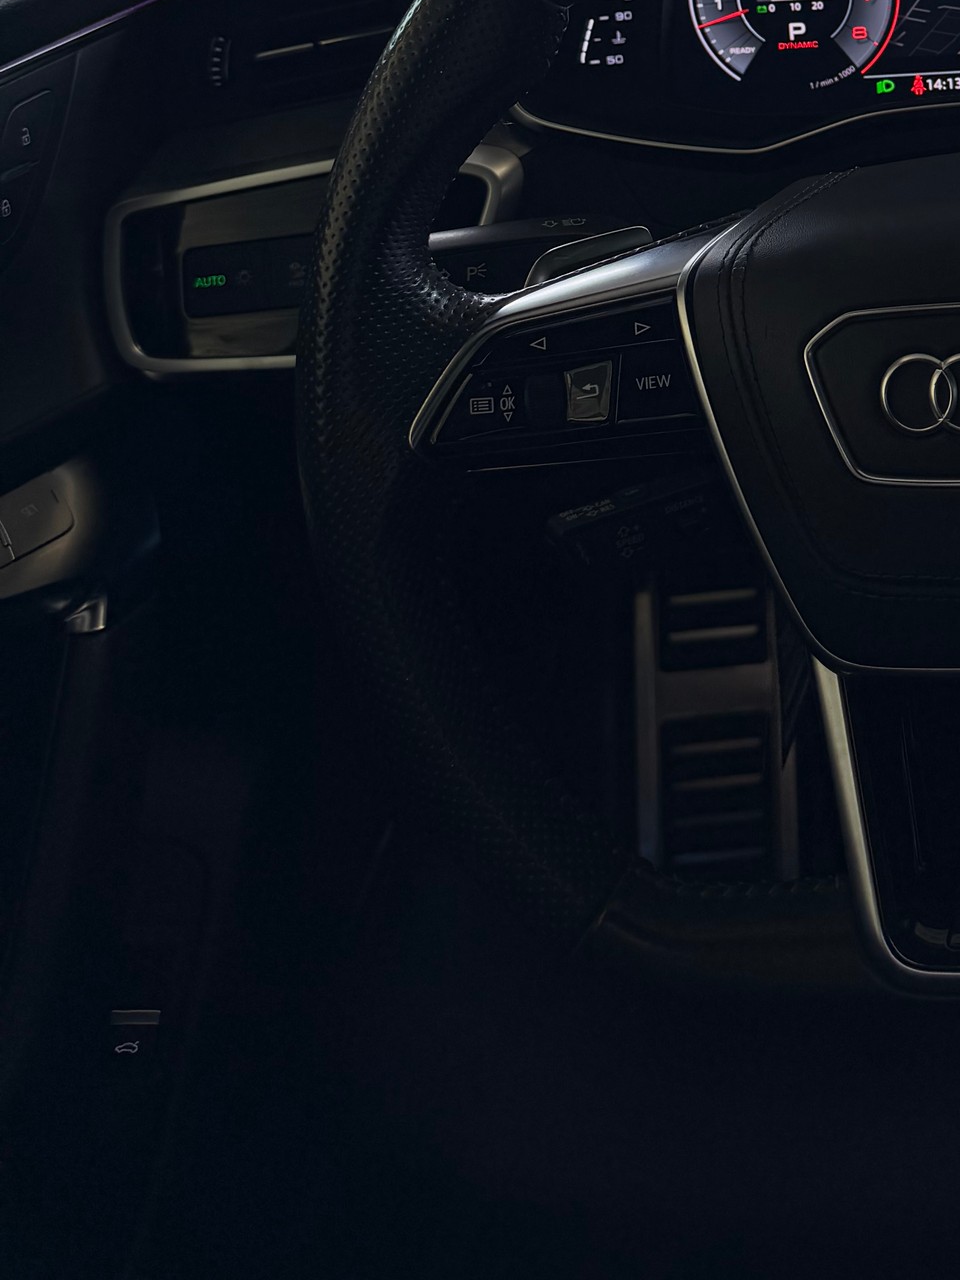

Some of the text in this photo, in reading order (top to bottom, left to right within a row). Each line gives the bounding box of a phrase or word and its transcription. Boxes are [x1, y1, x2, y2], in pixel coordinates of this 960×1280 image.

[768, 3, 776, 13] 0
[790, 2, 801, 11] 10
[811, 1, 824, 10] 20
[615, 10, 633, 21] 90
[788, 22, 806, 41] P
[851, 26, 867, 40] 8
[729, 46, 756, 55] READY
[778, 41, 819, 51] DYNAMIC
[606, 54, 624, 65] 50
[838, 65, 856, 79] 1000
[194, 274, 226, 288] AUTO
[635, 374, 671, 391] VIEW
[500, 396, 515, 411] OK
